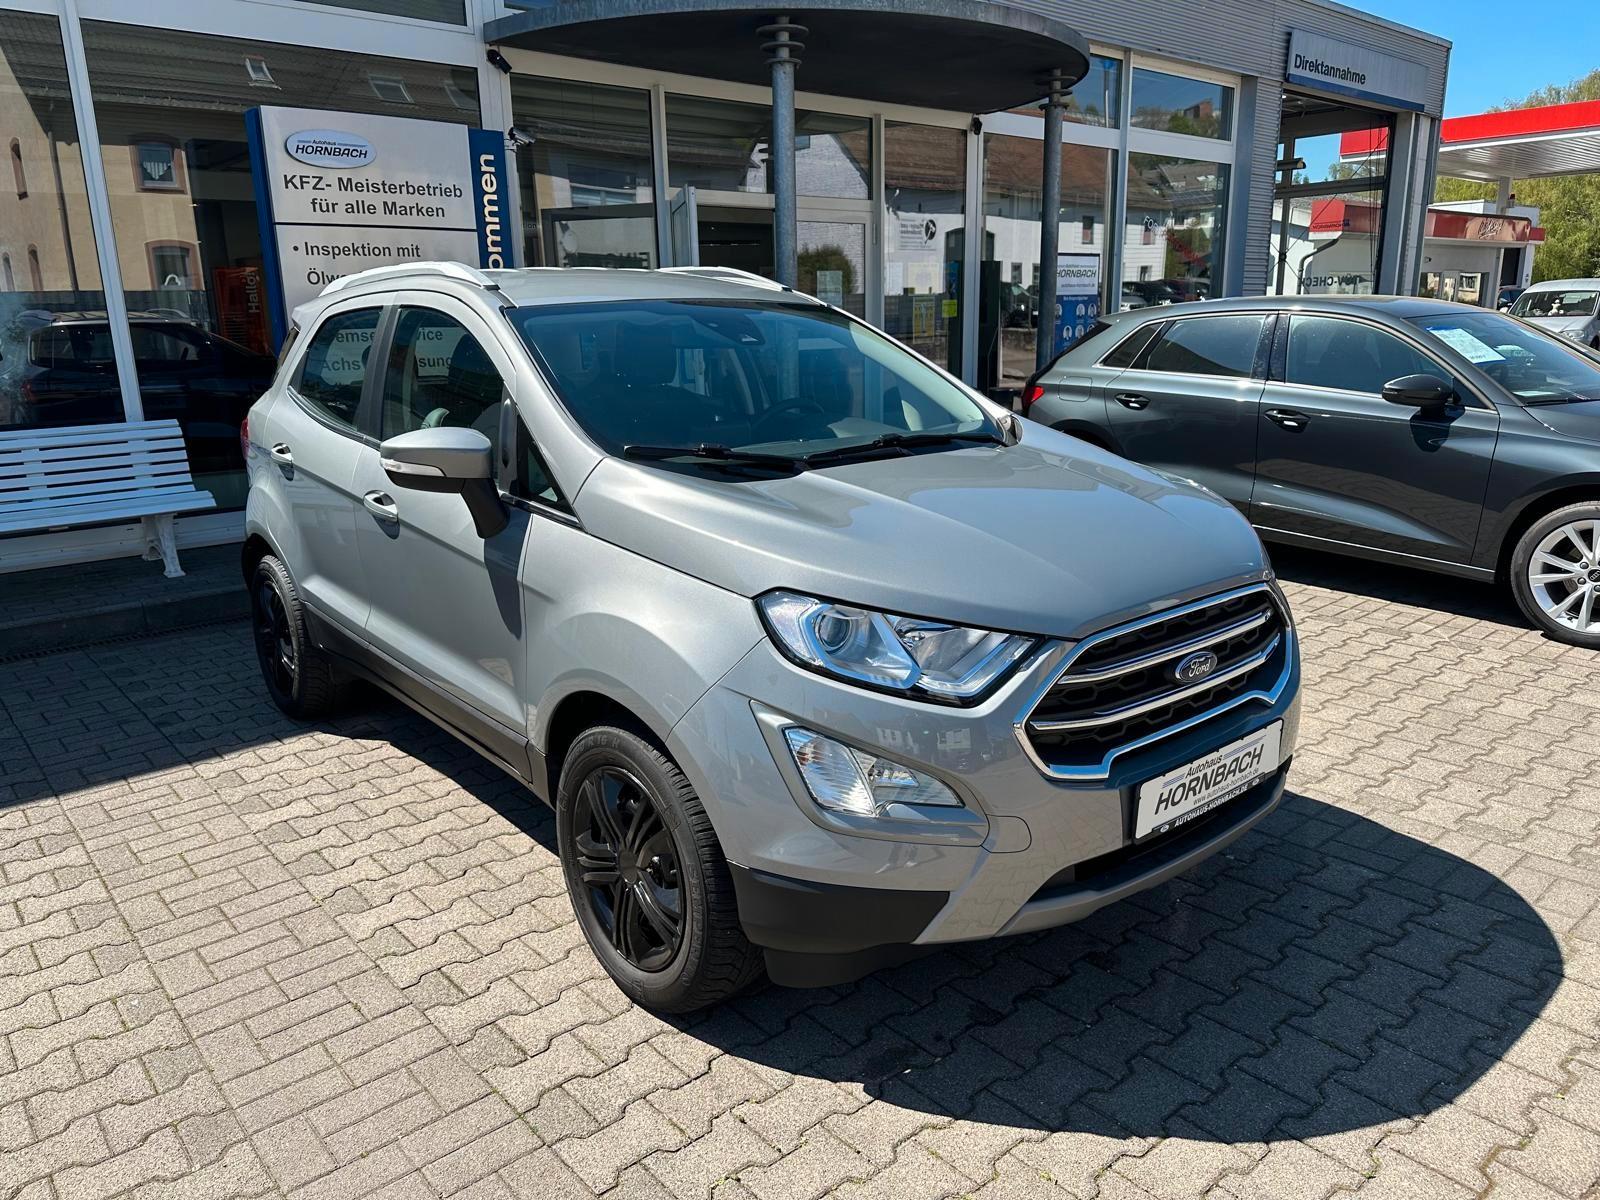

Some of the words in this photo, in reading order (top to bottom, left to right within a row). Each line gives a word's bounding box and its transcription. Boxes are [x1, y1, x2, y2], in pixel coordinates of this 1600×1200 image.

[1294, 53, 1366, 85] Direktannahme
[295, 144, 368, 159] HORNBACH
[283, 174, 332, 191] KFZ-
[337, 176, 463, 199] Meisterbetrieb
[310, 198, 339, 213] für
[344, 199, 377, 215] alle
[382, 200, 445, 218] Marken
[479, 153, 504, 269] ommen
[304, 241, 392, 259] Inspektion
[396, 243, 421, 258] mit
[1188, 655, 1211, 677] Ford
[1185, 754, 1223, 778] Autohaus
[1154, 743, 1264, 815] HORNBACH
